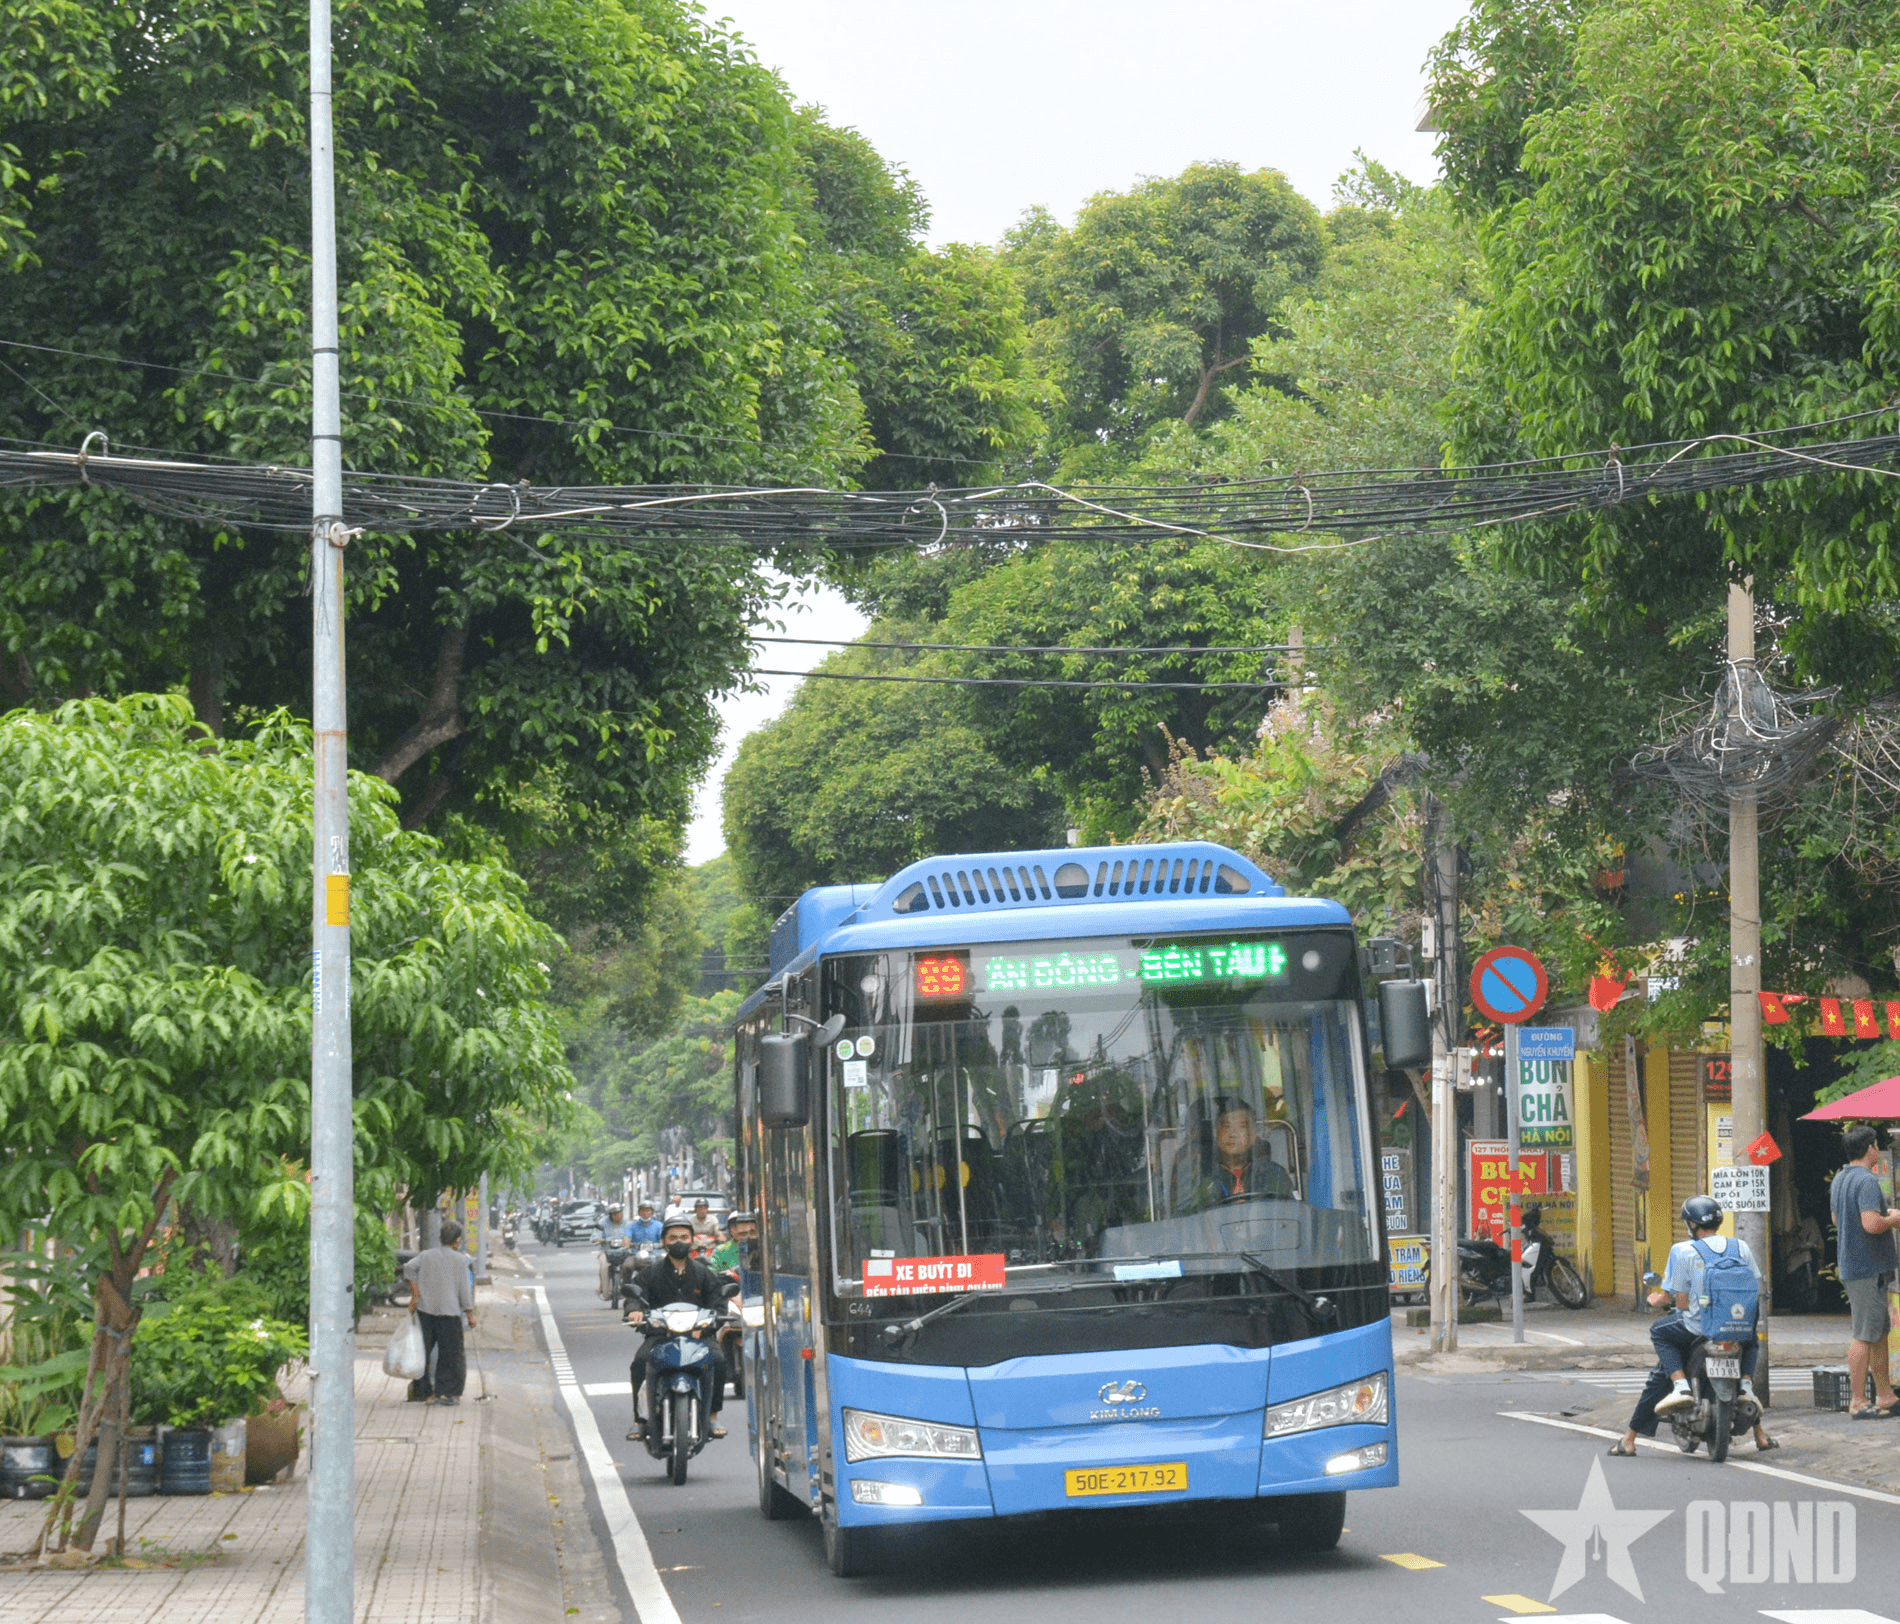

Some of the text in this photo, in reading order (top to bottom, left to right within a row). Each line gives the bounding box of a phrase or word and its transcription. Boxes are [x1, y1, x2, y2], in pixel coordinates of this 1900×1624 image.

[1521, 1085, 1568, 1123] CHẢ
[1521, 1126, 1571, 1145] HÀ NỘI
[1751, 1167, 1765, 1178] 10K
[1713, 1181, 1733, 1189] CAM
[1752, 1178, 1766, 1188] 15K
[1752, 1188, 1766, 1198] 15K
[896, 1260, 972, 1281] XE BUÝT ĐI
[1090, 1406, 1161, 1421] KIM LONG
[1076, 1469, 1177, 1491] 50E-217.92
